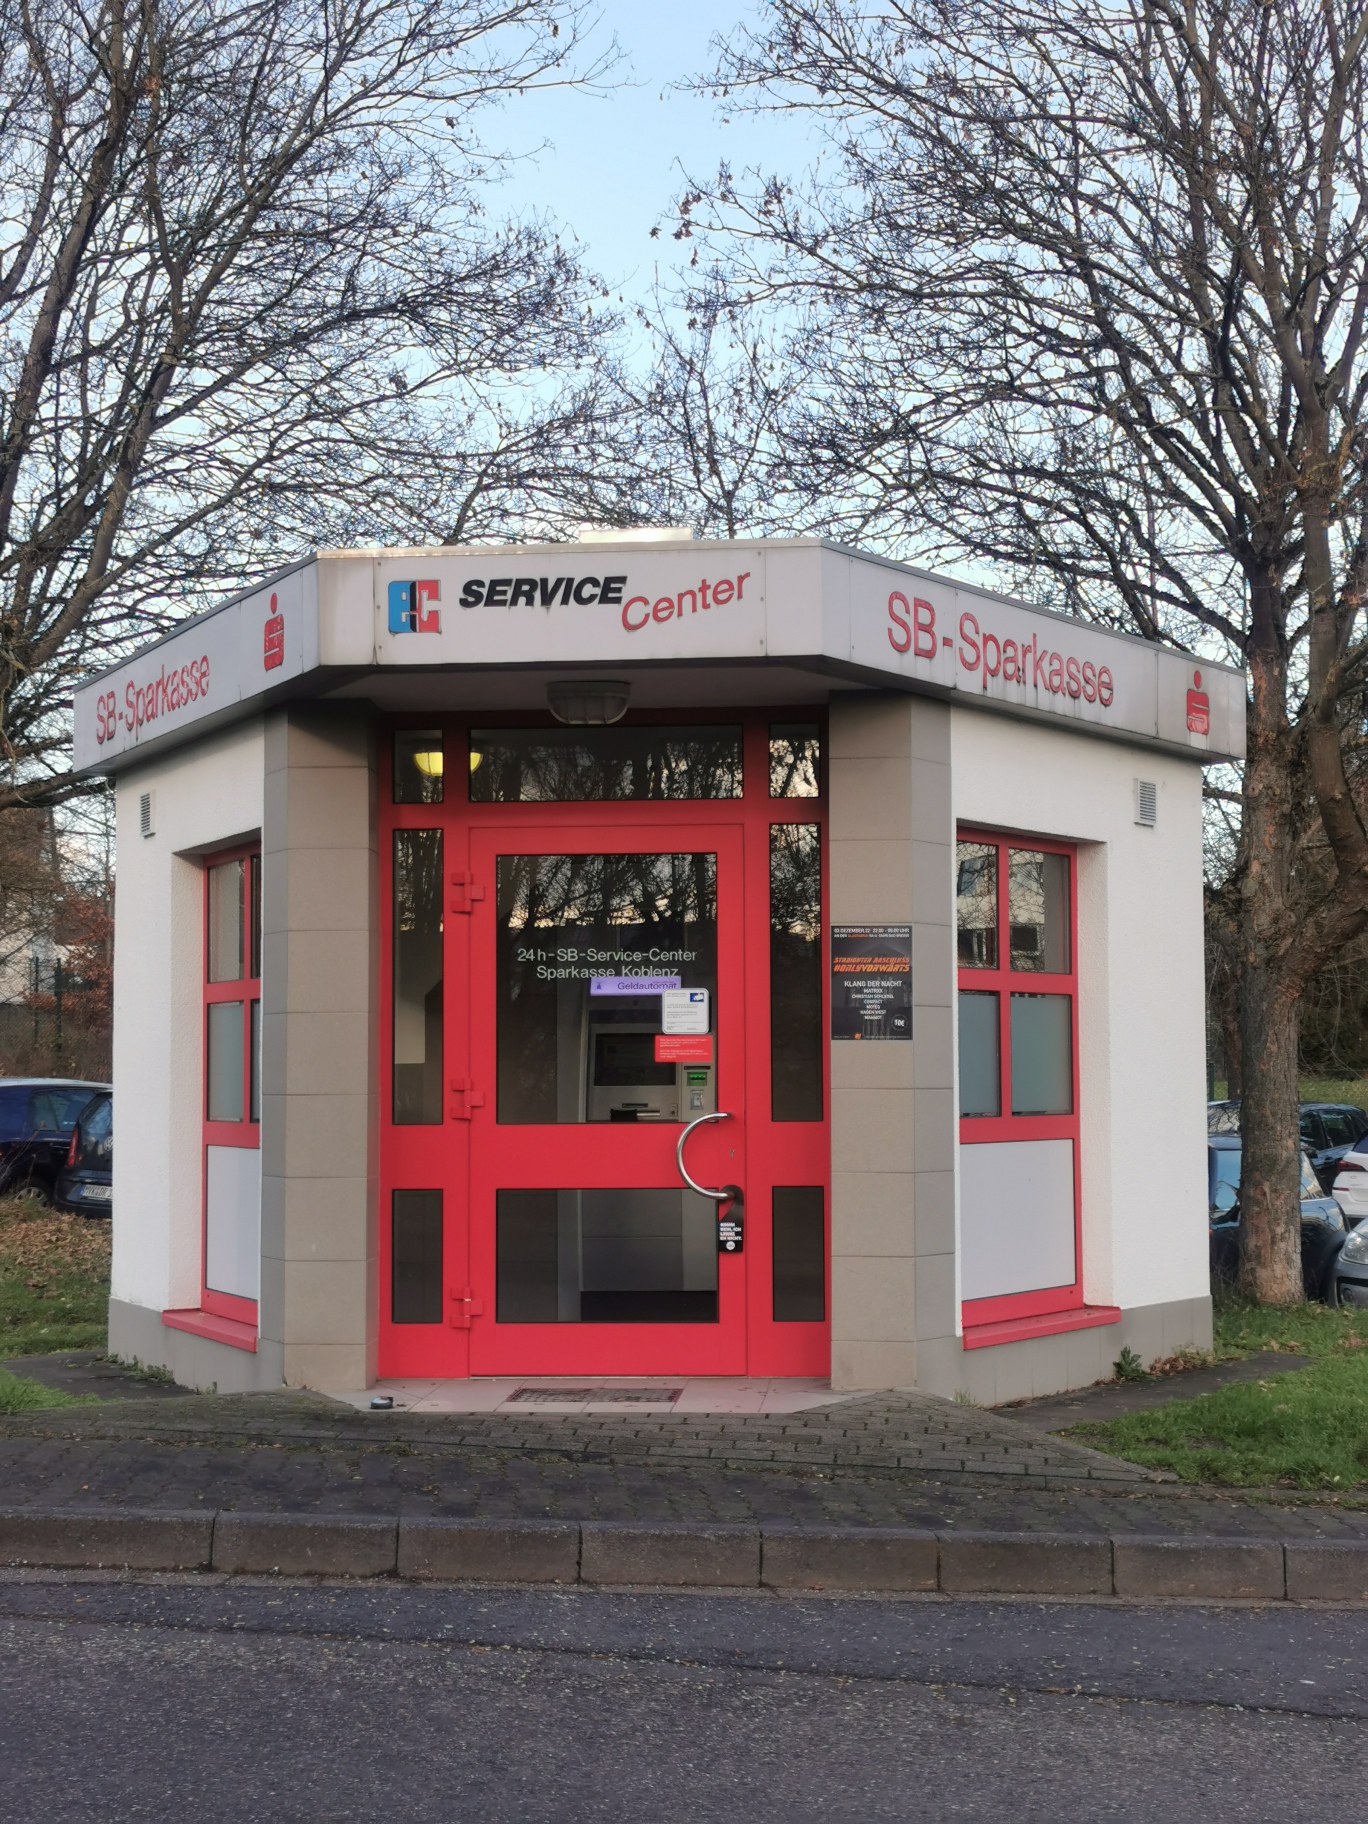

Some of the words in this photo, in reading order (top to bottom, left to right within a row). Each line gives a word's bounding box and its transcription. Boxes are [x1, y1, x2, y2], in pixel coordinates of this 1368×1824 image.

[459, 574, 628, 609] SERVICE
[621, 572, 751, 632] Center
[887, 590, 1115, 708] SB-Sparkasse
[95, 654, 211, 746] SB-Sparkasse
[536, 965, 616, 980] Sparkasse
[621, 965, 679, 977] Koblenz
[617, 981, 678, 991] Geldautomat
